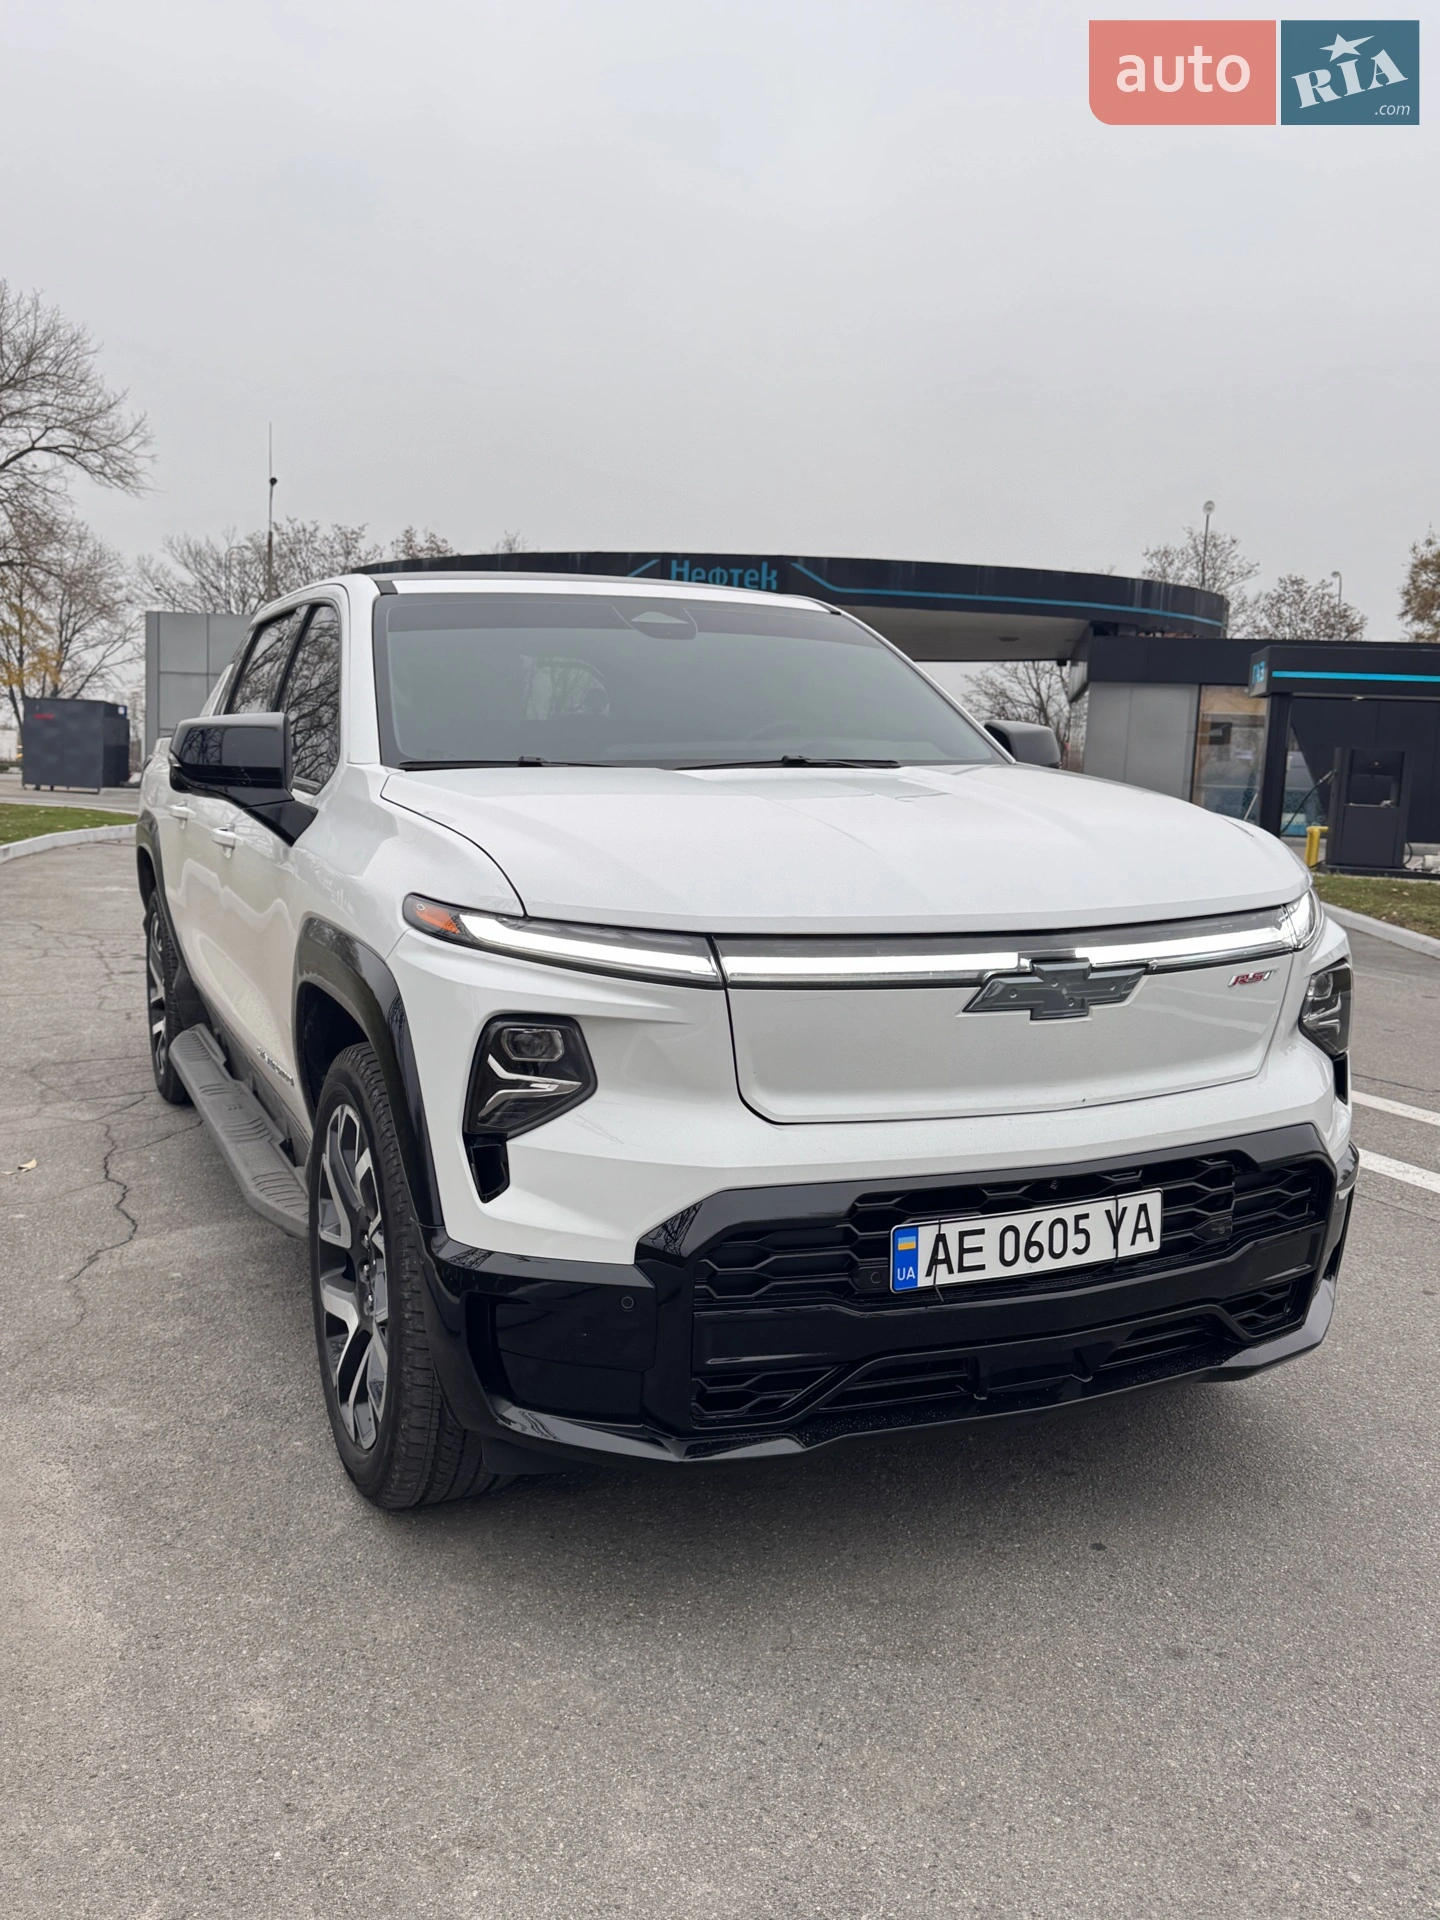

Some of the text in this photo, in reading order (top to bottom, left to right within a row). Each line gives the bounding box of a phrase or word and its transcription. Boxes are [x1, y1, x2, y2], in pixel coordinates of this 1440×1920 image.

[1227, 968, 1279, 988] RST
[925, 1202, 1155, 1278] AE 0605 YA
[896, 1266, 916, 1281] UA
